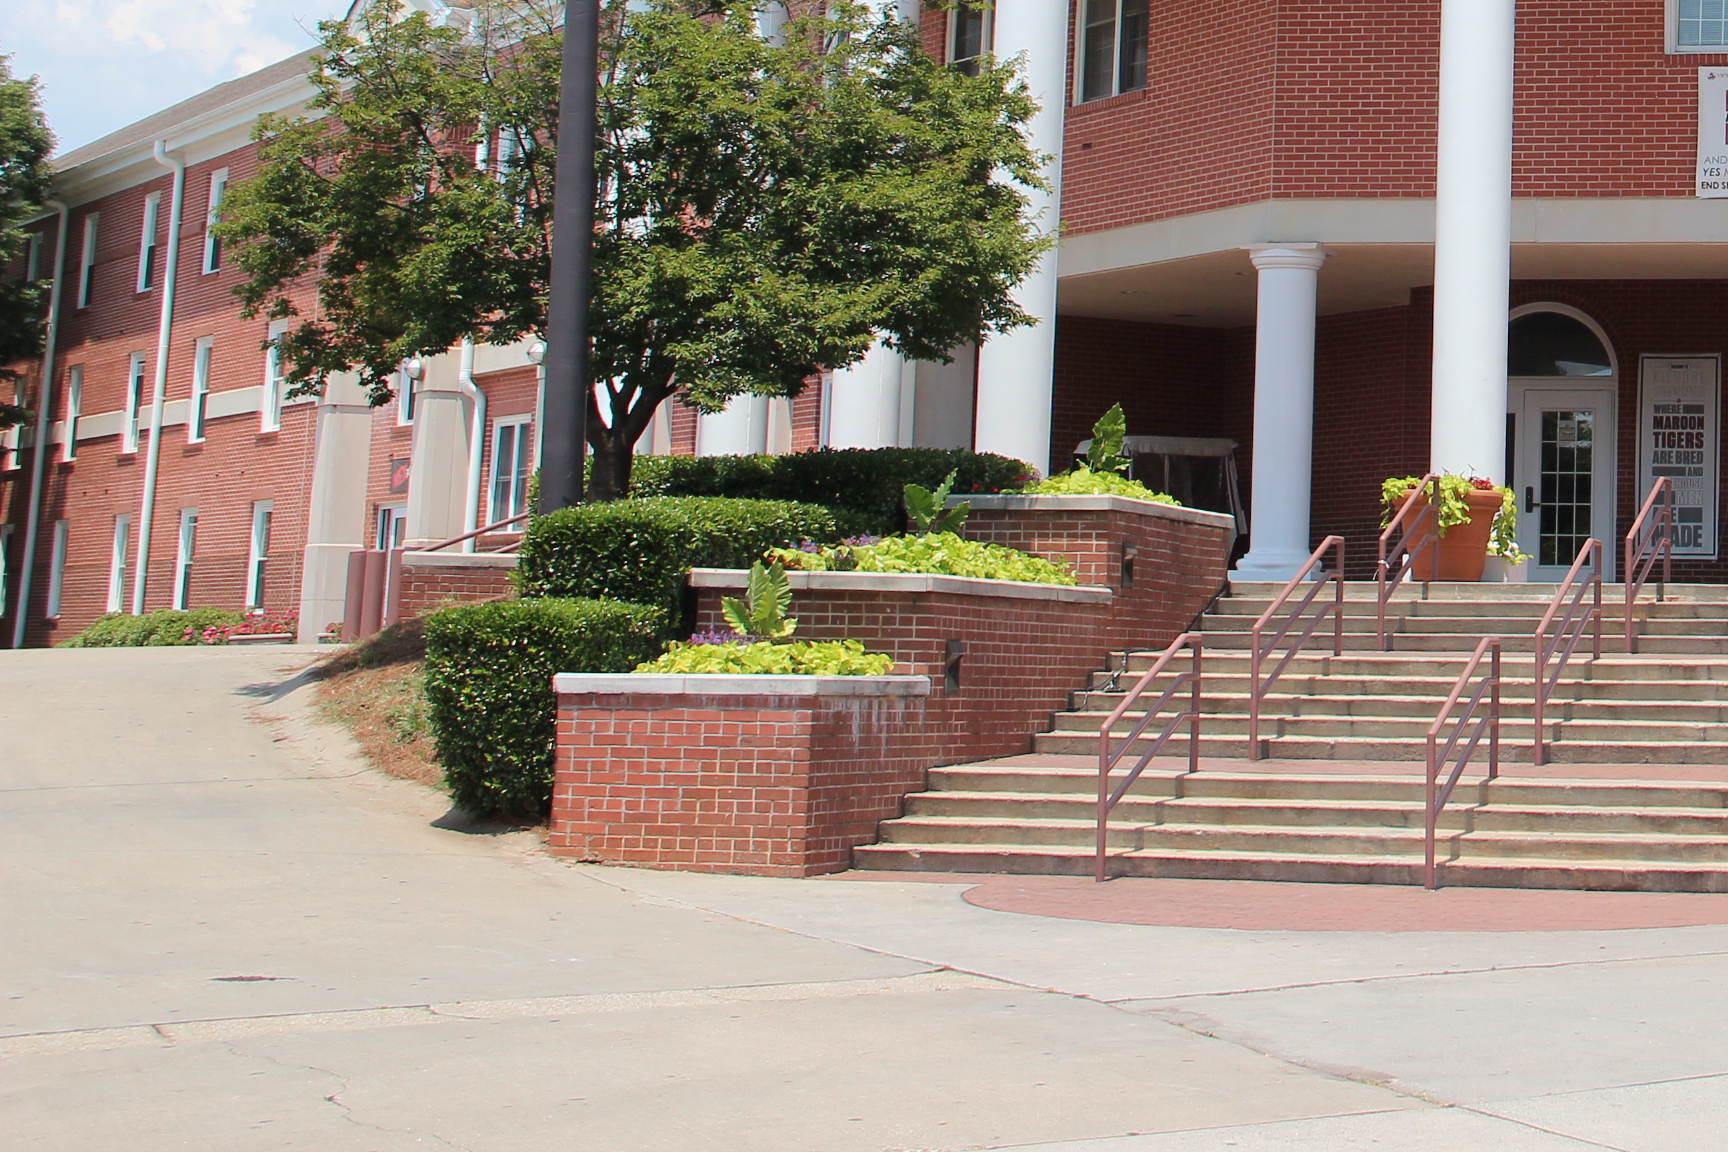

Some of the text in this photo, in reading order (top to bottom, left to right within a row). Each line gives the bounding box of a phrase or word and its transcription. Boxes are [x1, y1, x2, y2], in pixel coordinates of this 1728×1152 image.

[1704, 155, 1728, 165] AND
[1703, 167, 1721, 177] YES
[1701, 181, 1719, 190] END
[1653, 404, 1682, 414] WHERE
[1653, 415, 1705, 430] MAROON
[1653, 432, 1704, 449] TIGERS
[1652, 450, 1704, 464] ARE BRED
[1687, 466, 1703, 477] AND
[1675, 490, 1703, 506] MEN
